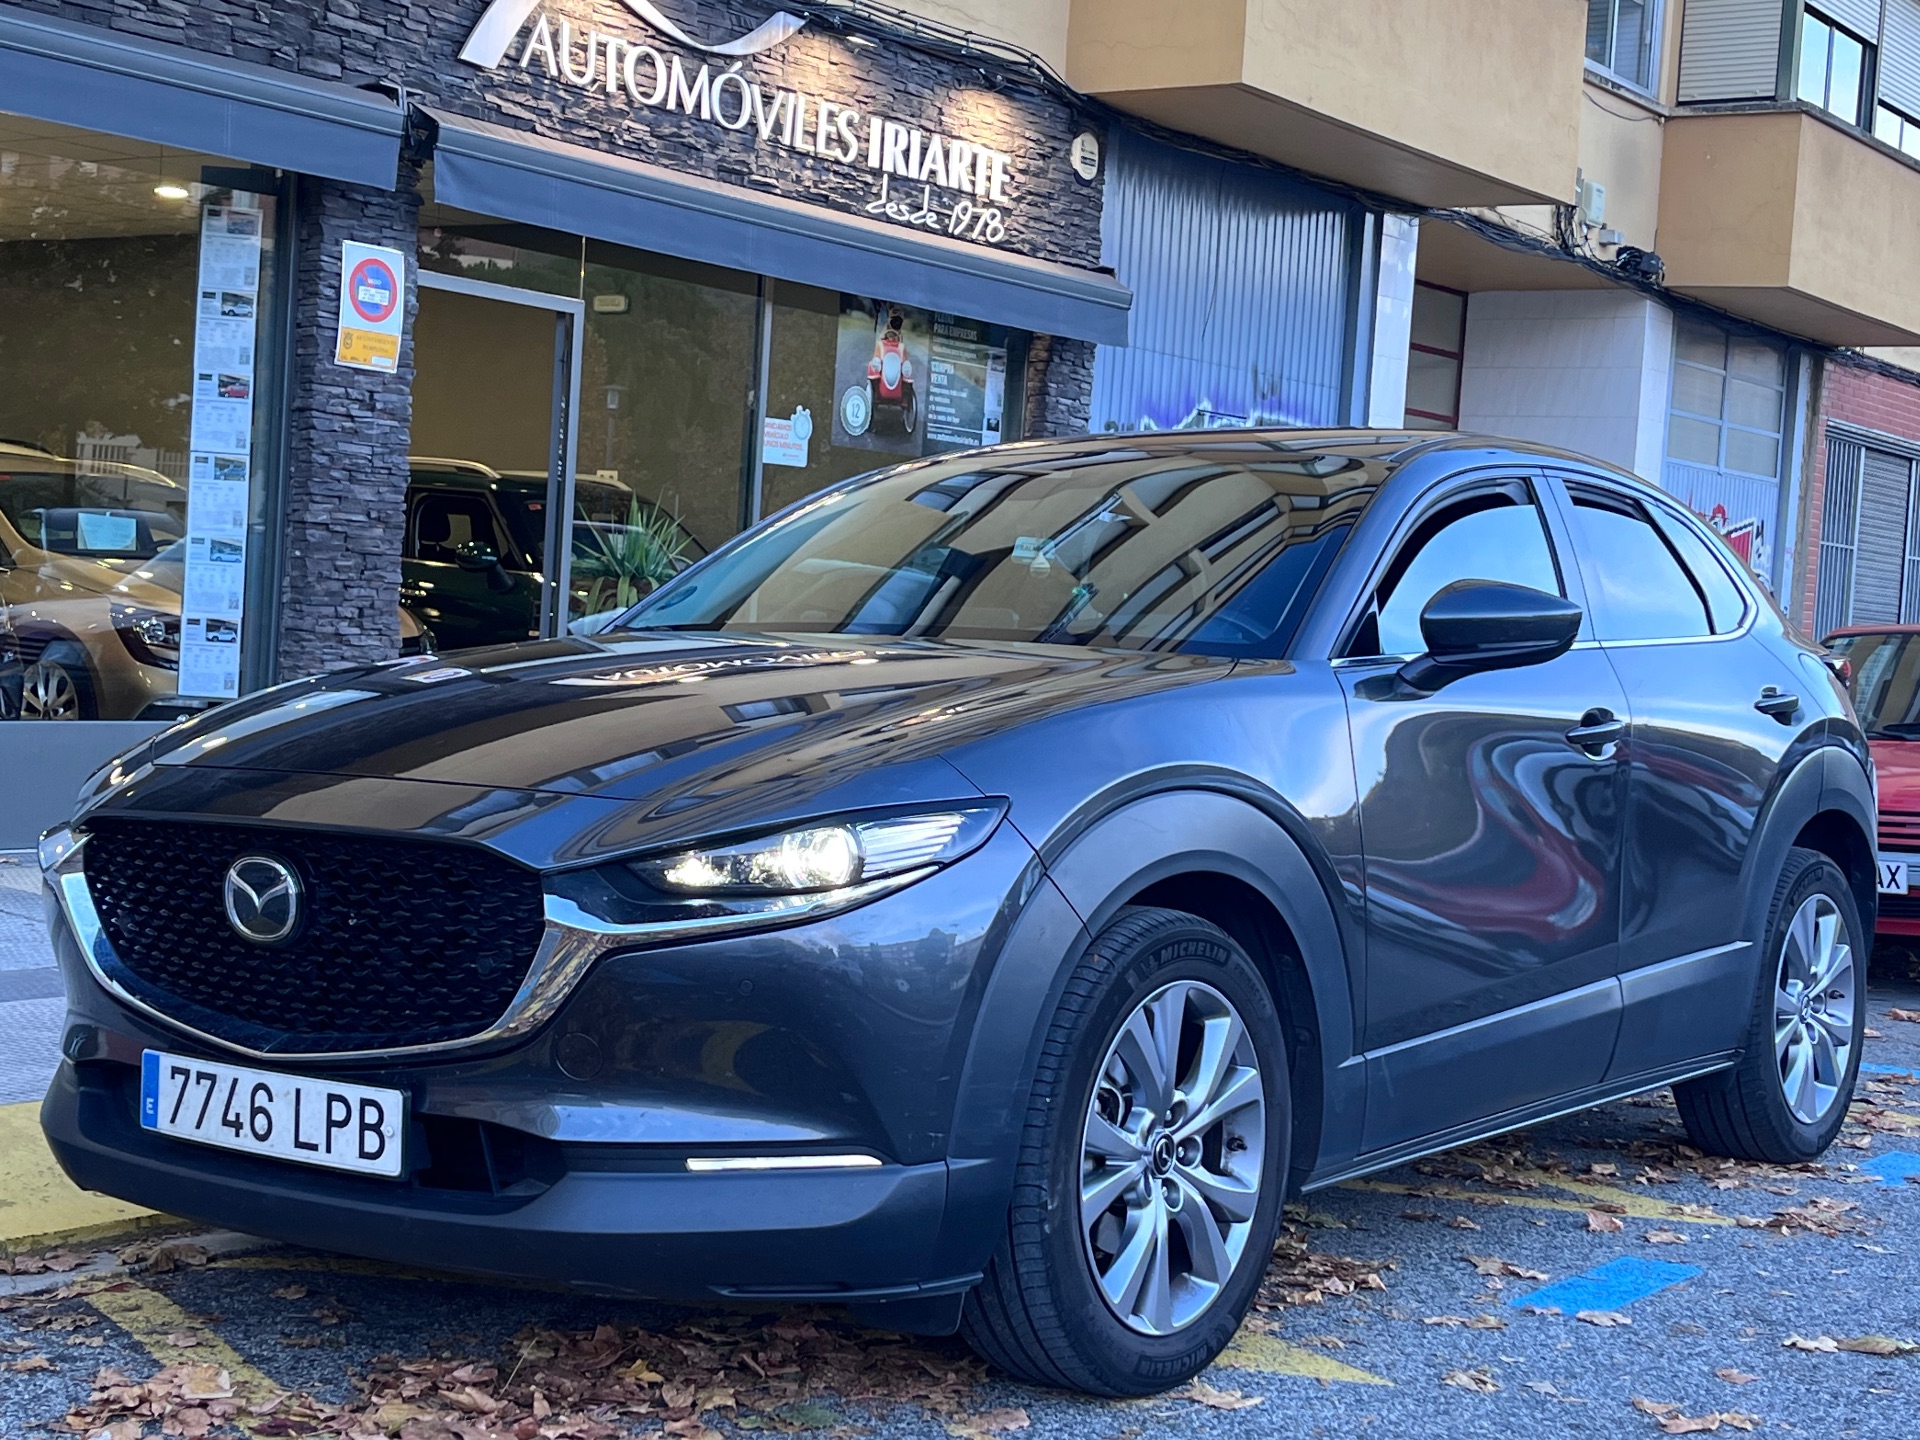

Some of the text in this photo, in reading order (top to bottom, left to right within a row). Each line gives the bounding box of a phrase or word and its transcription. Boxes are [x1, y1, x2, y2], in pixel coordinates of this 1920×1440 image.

[520, 13, 1012, 203] AUTOMÓVILES IRIARTE
[866, 175, 1005, 243] desde 1978
[851, 403, 861, 418] 12
[1160, 940, 1227, 964] MICHELIN
[146, 1097, 155, 1115] E
[170, 1066, 386, 1161] 7746 LPB
